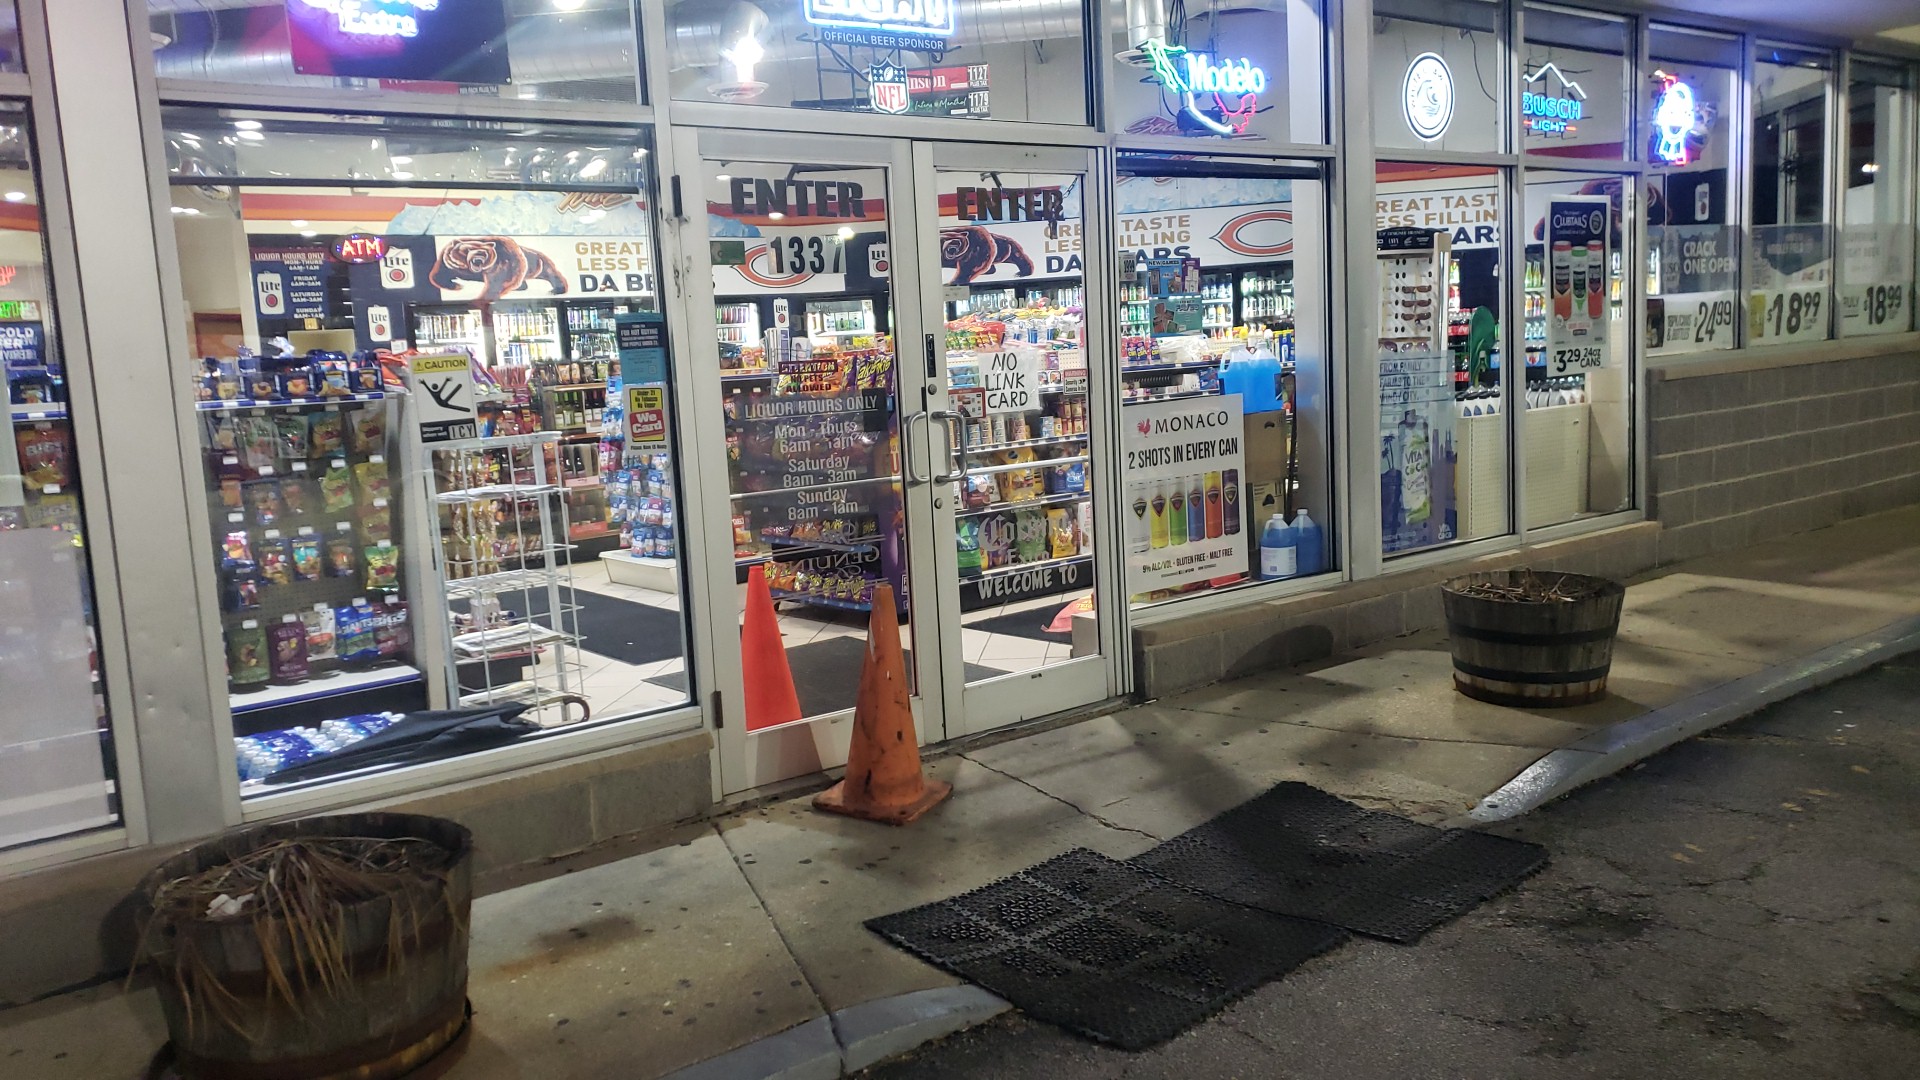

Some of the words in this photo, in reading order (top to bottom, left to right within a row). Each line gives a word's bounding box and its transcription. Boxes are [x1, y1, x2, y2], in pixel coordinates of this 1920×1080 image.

[823, 31, 868, 44] OFFICIAL
[870, 35, 896, 47] BEER
[898, 37, 944, 50] SPONSOR
[1185, 53, 1265, 94] Modelo
[876, 84, 906, 110] NFL
[1523, 91, 1581, 120] BUSCH
[1532, 119, 1567, 132] LIGHT
[730, 177, 866, 218] ENTER
[957, 187, 1065, 221] ENTER
[1121, 215, 1190, 232] TASTE
[254, 252, 281, 260] LIQUOR
[282, 252, 306, 260] HOURS
[307, 252, 325, 260] ONLY
[342, 240, 380, 256] ATM
[575, 242, 643, 256] GREAT
[770, 236, 842, 273] 1337
[1683, 240, 1717, 258] CRACK
[383, 256, 409, 268] Lite
[577, 258, 630, 272] LESS
[1683, 258, 1707, 275] ONE
[1708, 257, 1737, 274] OPEN
[260, 281, 281, 293] Lite
[580, 273, 620, 292] DA
[776, 304, 787, 313] Lite
[370, 313, 387, 323] Lite
[424, 359, 467, 370] CAUTION
[991, 352, 1017, 371] NO
[1580, 356, 1601, 368] CANS
[804, 373, 824, 383] PETS
[984, 372, 1025, 391] LINK
[786, 383, 832, 393] ALLOWED
[745, 401, 794, 418] LIQUOR
[798, 398, 842, 414] HOURS
[847, 395, 877, 410] ONLY
[987, 391, 1028, 409] CARD
[632, 420, 663, 433] Card
[636, 412, 657, 423] We
[1155, 411, 1229, 434] MONACO
[451, 424, 474, 439] ICY
[775, 425, 806, 440] Mon
[819, 421, 858, 435] Thurs
[780, 440, 811, 454] 6am
[1128, 451, 1136, 470] 2
[1138, 446, 1171, 469] SHOTS
[1173, 444, 1184, 463] IN
[1186, 440, 1217, 461] EVERY
[1218, 437, 1238, 456] CAN
[788, 454, 849, 473] Saturday
[783, 473, 814, 488] 8am
[827, 469, 857, 483] 3am
[797, 486, 848, 505] Sunday
[787, 506, 819, 521] 8am
[831, 501, 858, 515] 1am
[1176, 555, 1194, 567] GLUTEN
[1194, 553, 1206, 564] FREE
[1209, 549, 1222, 560] MALT
[1222, 547, 1233, 557] FREE
[978, 568, 1053, 600] WELCOME
[1059, 564, 1078, 584] TO
